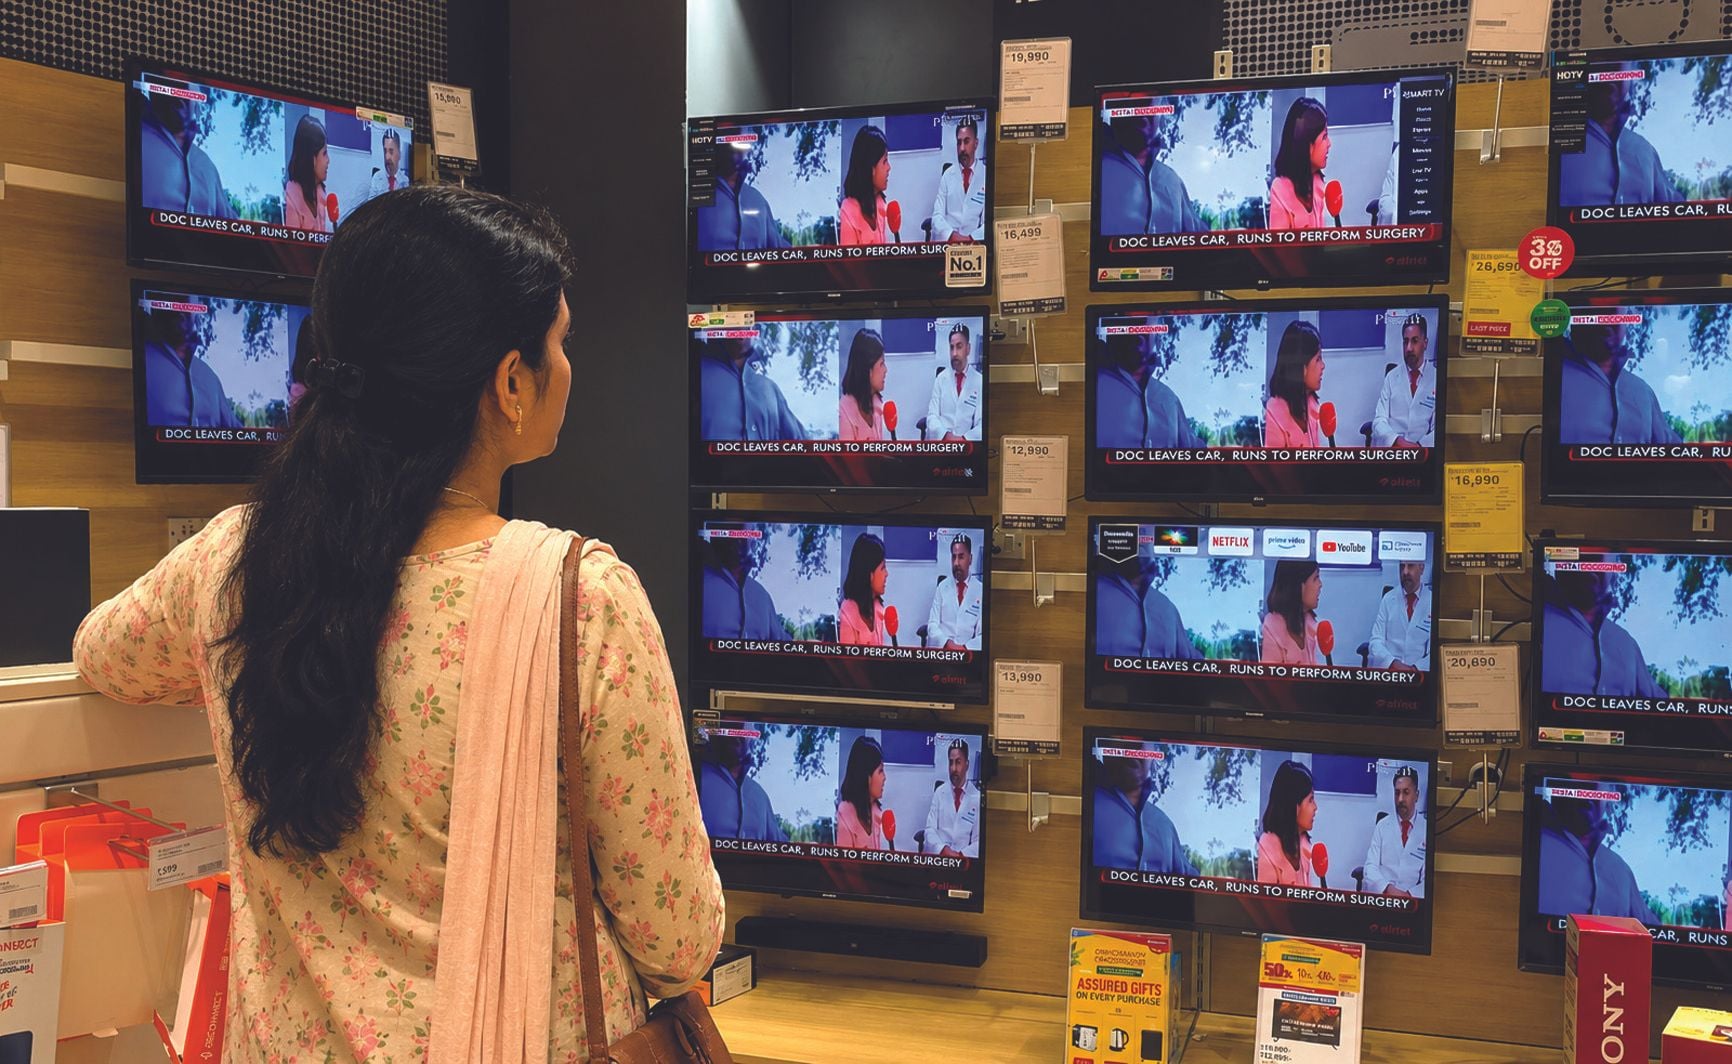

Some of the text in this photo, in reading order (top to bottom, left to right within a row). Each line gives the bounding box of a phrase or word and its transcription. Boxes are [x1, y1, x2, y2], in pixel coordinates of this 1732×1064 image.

[1434, 88, 1445, 97] TV
[1581, 207, 1615, 220] DOC
[1619, 205, 1670, 218] LEAVES
[1674, 204, 1709, 217] CAR,
[159, 212, 187, 226] DOC
[189, 216, 228, 231] LEAVES
[230, 222, 256, 236] CAR,
[260, 225, 289, 239] RUNS
[290, 230, 306, 241] TO
[1003, 227, 1042, 241] 16,499
[1119, 227, 1426, 249] DOC LEAVES CAR, RUNS TO PERFORM SURGERY
[713, 252, 738, 263] DOC
[741, 250, 779, 262] LEAVES
[781, 249, 808, 261] CAR,
[813, 247, 843, 259] RUNS
[845, 247, 863, 258] TO
[865, 245, 917, 257] PERFORM
[949, 255, 982, 272] No.1
[1528, 256, 1563, 270] OFF
[165, 428, 192, 439] DOC
[195, 429, 234, 441] LEAVES
[236, 430, 261, 442] CAR,
[716, 442, 966, 453] DOC LEAVES CAR, RUNS TO PERFORM SURGERY
[1010, 445, 1050, 457] 12,990
[1580, 446, 1613, 457] DOC
[1617, 446, 1666, 458] LEAVES
[1670, 446, 1704, 459] CAR,
[1115, 449, 1419, 462] DOC LEAVES CAR, RUNS TO PERFORM SURGERY
[1455, 474, 1501, 488] 16,990
[1211, 536, 1250, 548] NETFLIX
[1267, 535, 1288, 545] prime
[717, 639, 966, 661] DOC LEAVES CAR, RUNS TO PERFORM SURGERY
[1002, 671, 1043, 684] 13,990
[1113, 658, 1416, 683] DOC LEAVES CAR, RUNS TO PERFORM SURGERY
[1563, 696, 1597, 708] DOC
[1601, 697, 1651, 711] LEAVES
[1655, 700, 1689, 715] CAR,
[715, 839, 962, 868] DOC LEAVES CAR, RUNS TO PERFORM SURGERY
[1110, 870, 1410, 909] DOC LEAVES CAR, RUNS TO PERFORM SURGERY
[1688, 931, 1728, 946] RUNS
[1076, 976, 1163, 997] ASSURED GIFTS
[1075, 990, 1089, 1000] ON
[1089, 991, 1116, 1003] EVERY
